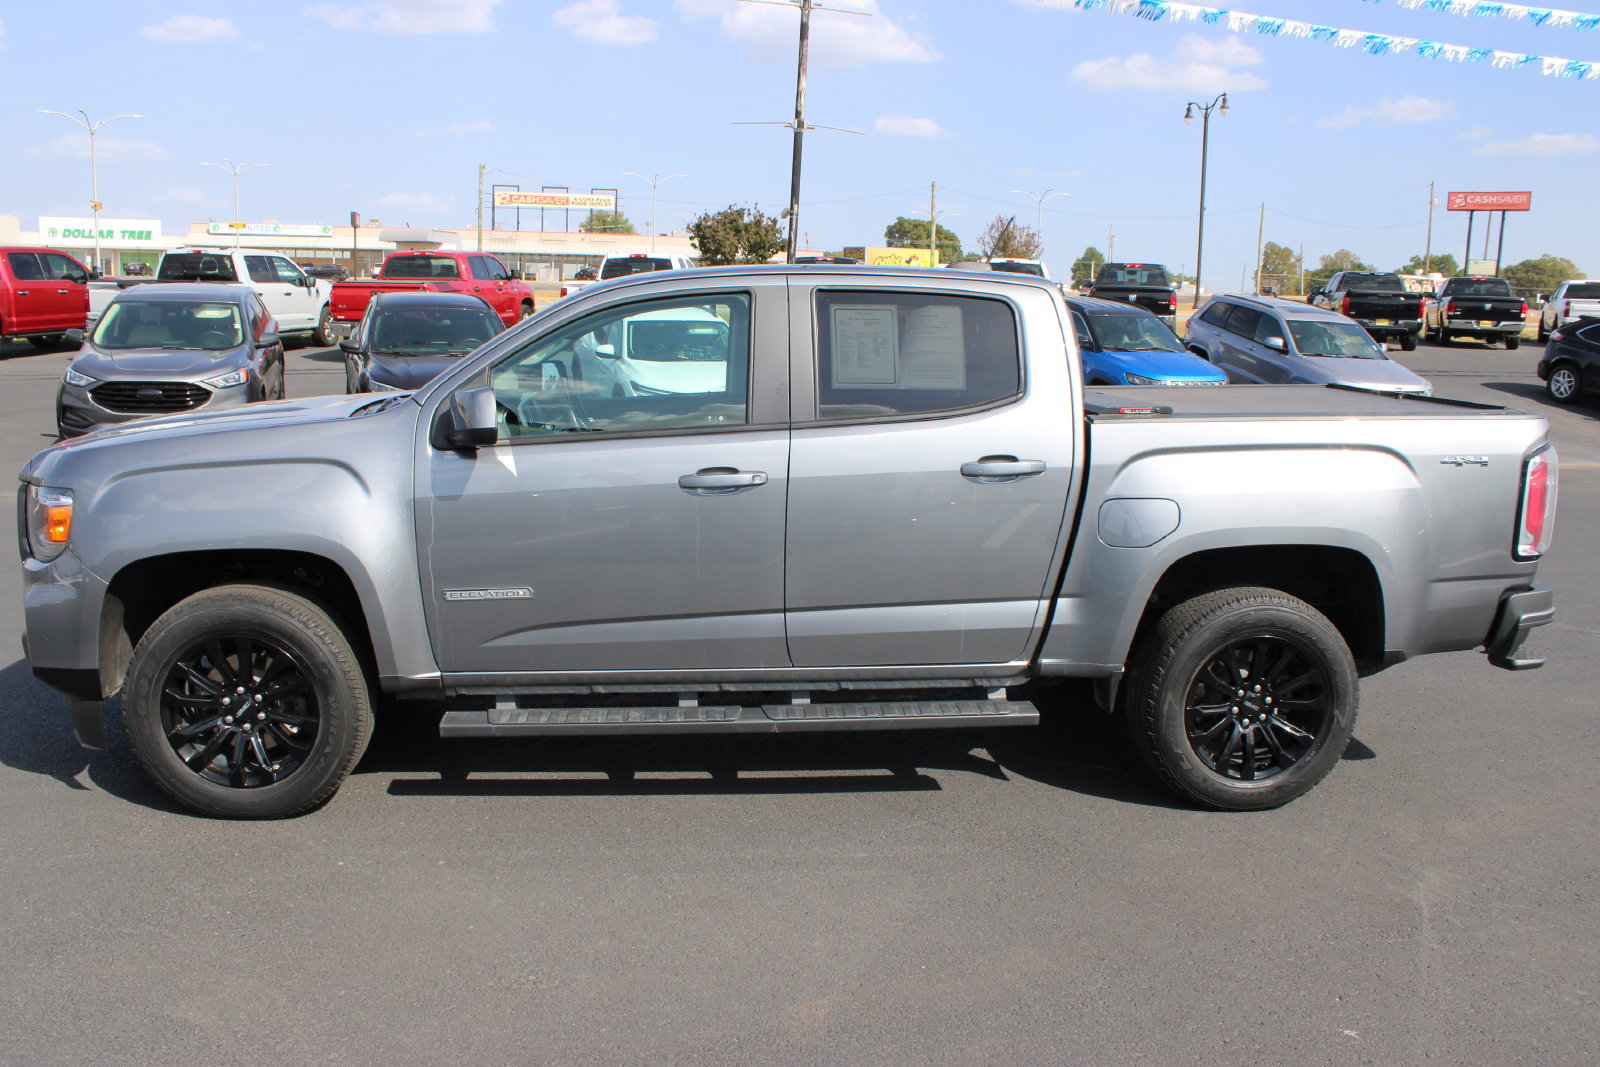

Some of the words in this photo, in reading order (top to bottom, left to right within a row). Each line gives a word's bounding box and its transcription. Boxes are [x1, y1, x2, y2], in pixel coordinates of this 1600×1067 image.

[1466, 195, 1527, 204] CASHSAVER
[62, 228, 115, 239] DOLLAR
[120, 230, 152, 240] TREE
[449, 589, 526, 599] ELEVATION
